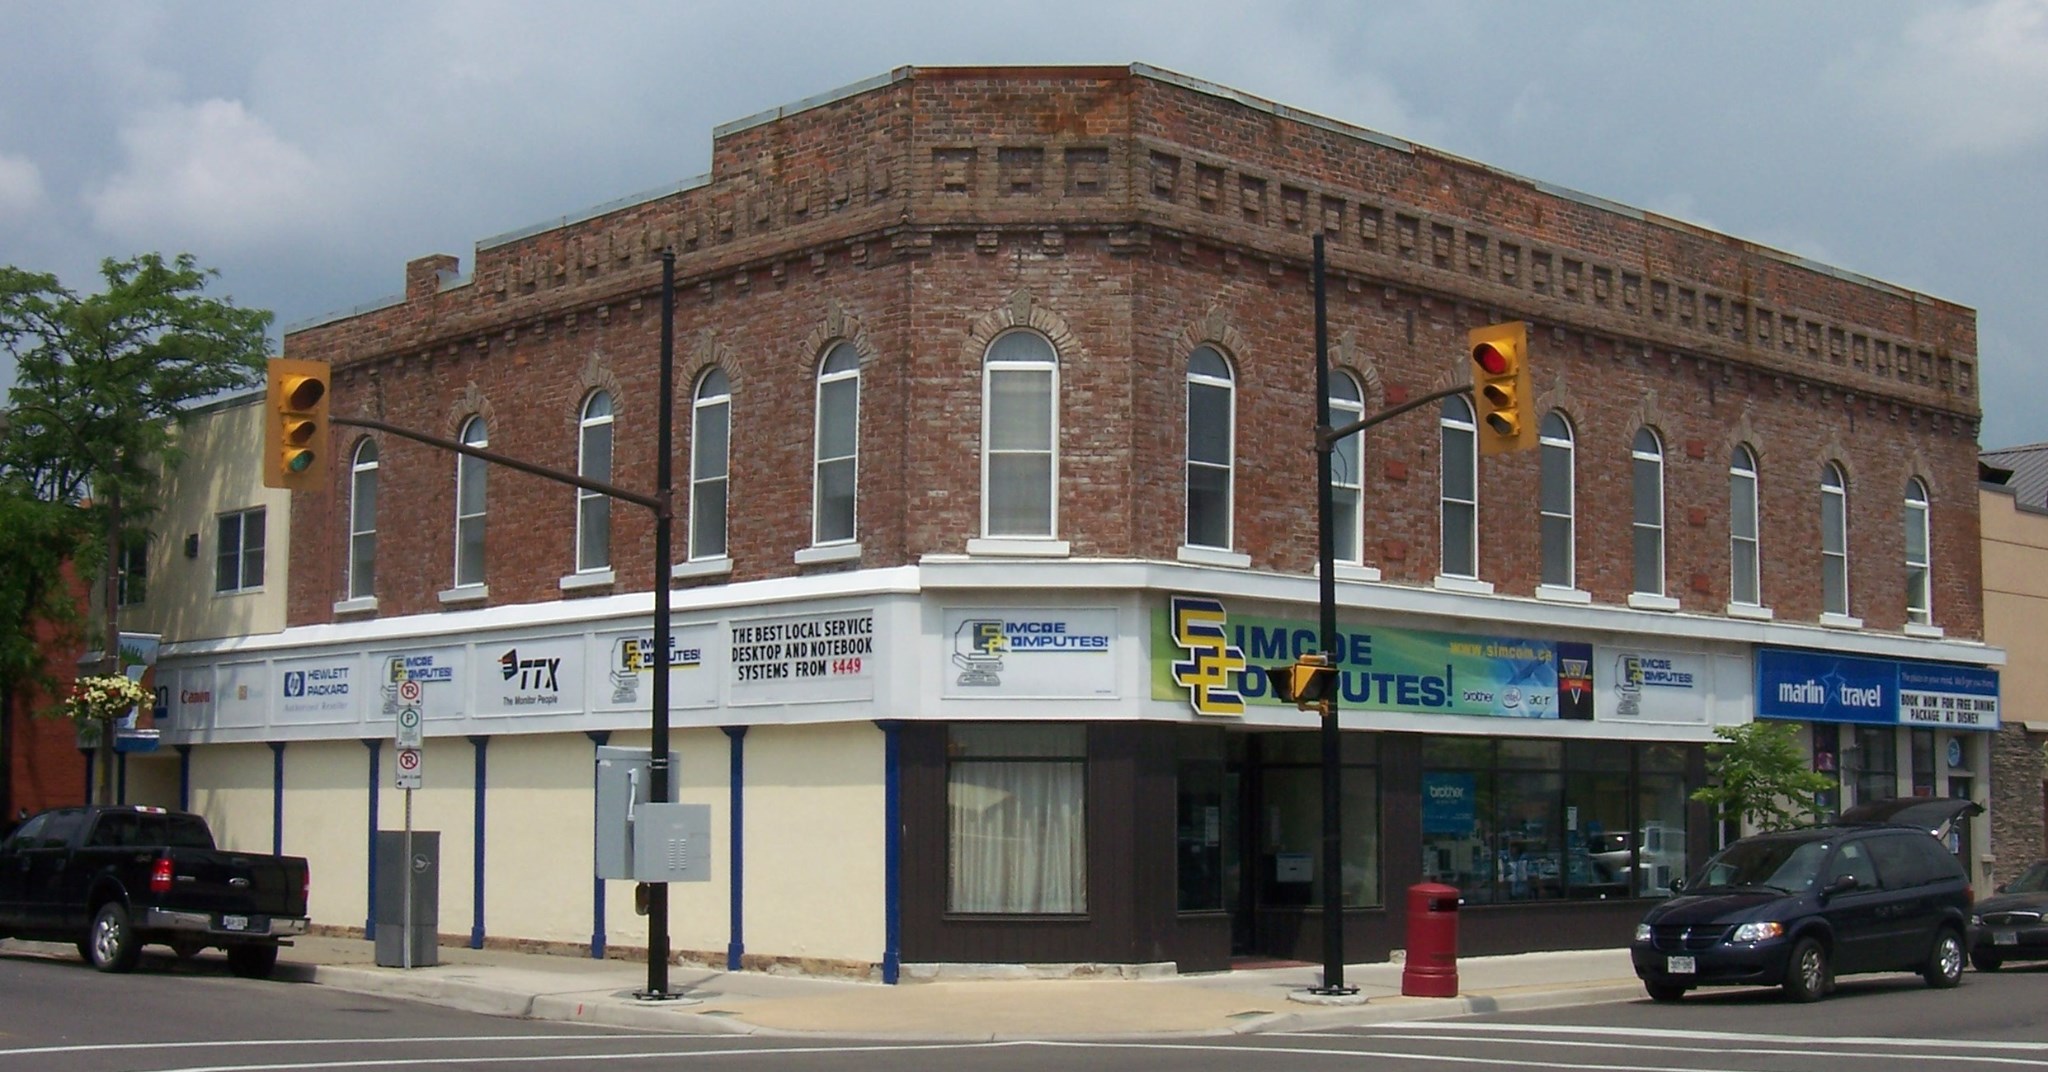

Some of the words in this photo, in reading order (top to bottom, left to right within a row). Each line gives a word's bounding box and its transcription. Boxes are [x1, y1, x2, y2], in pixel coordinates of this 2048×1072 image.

[732, 628, 752, 643] THE
[756, 625, 782, 641] BEST
[786, 622, 821, 639] LOCAL
[824, 618, 872, 636] SERVICE
[732, 644, 781, 662] DESKTOP
[785, 642, 807, 658] AND
[811, 637, 872, 657] NOTEBOOK
[308, 667, 349, 680] HEWLETT
[738, 662, 788, 680] SYSTEMS
[796, 660, 826, 677] FROM
[832, 658, 861, 674] $449
[181, 689, 210, 704] Canon
[307, 683, 349, 696] PACKARD
[1463, 690, 1494, 703] brother
[1779, 680, 1824, 705] marlin
[1840, 684, 1881, 707] travel
[503, 696, 513, 705] The
[515, 695, 536, 705] Monitor
[537, 694, 558, 705] People
[1901, 694, 1919, 706] BOOK
[1923, 695, 1938, 708] NOW
[1942, 696, 1955, 709] FOR
[1956, 698, 1971, 710] FREE
[1974, 700, 1995, 712] DINING
[1910, 709, 1940, 722] PACKAGE
[1945, 711, 1954, 722] AT
[1957, 712, 1979, 724] DISNEY
[1430, 785, 1464, 798] brother
